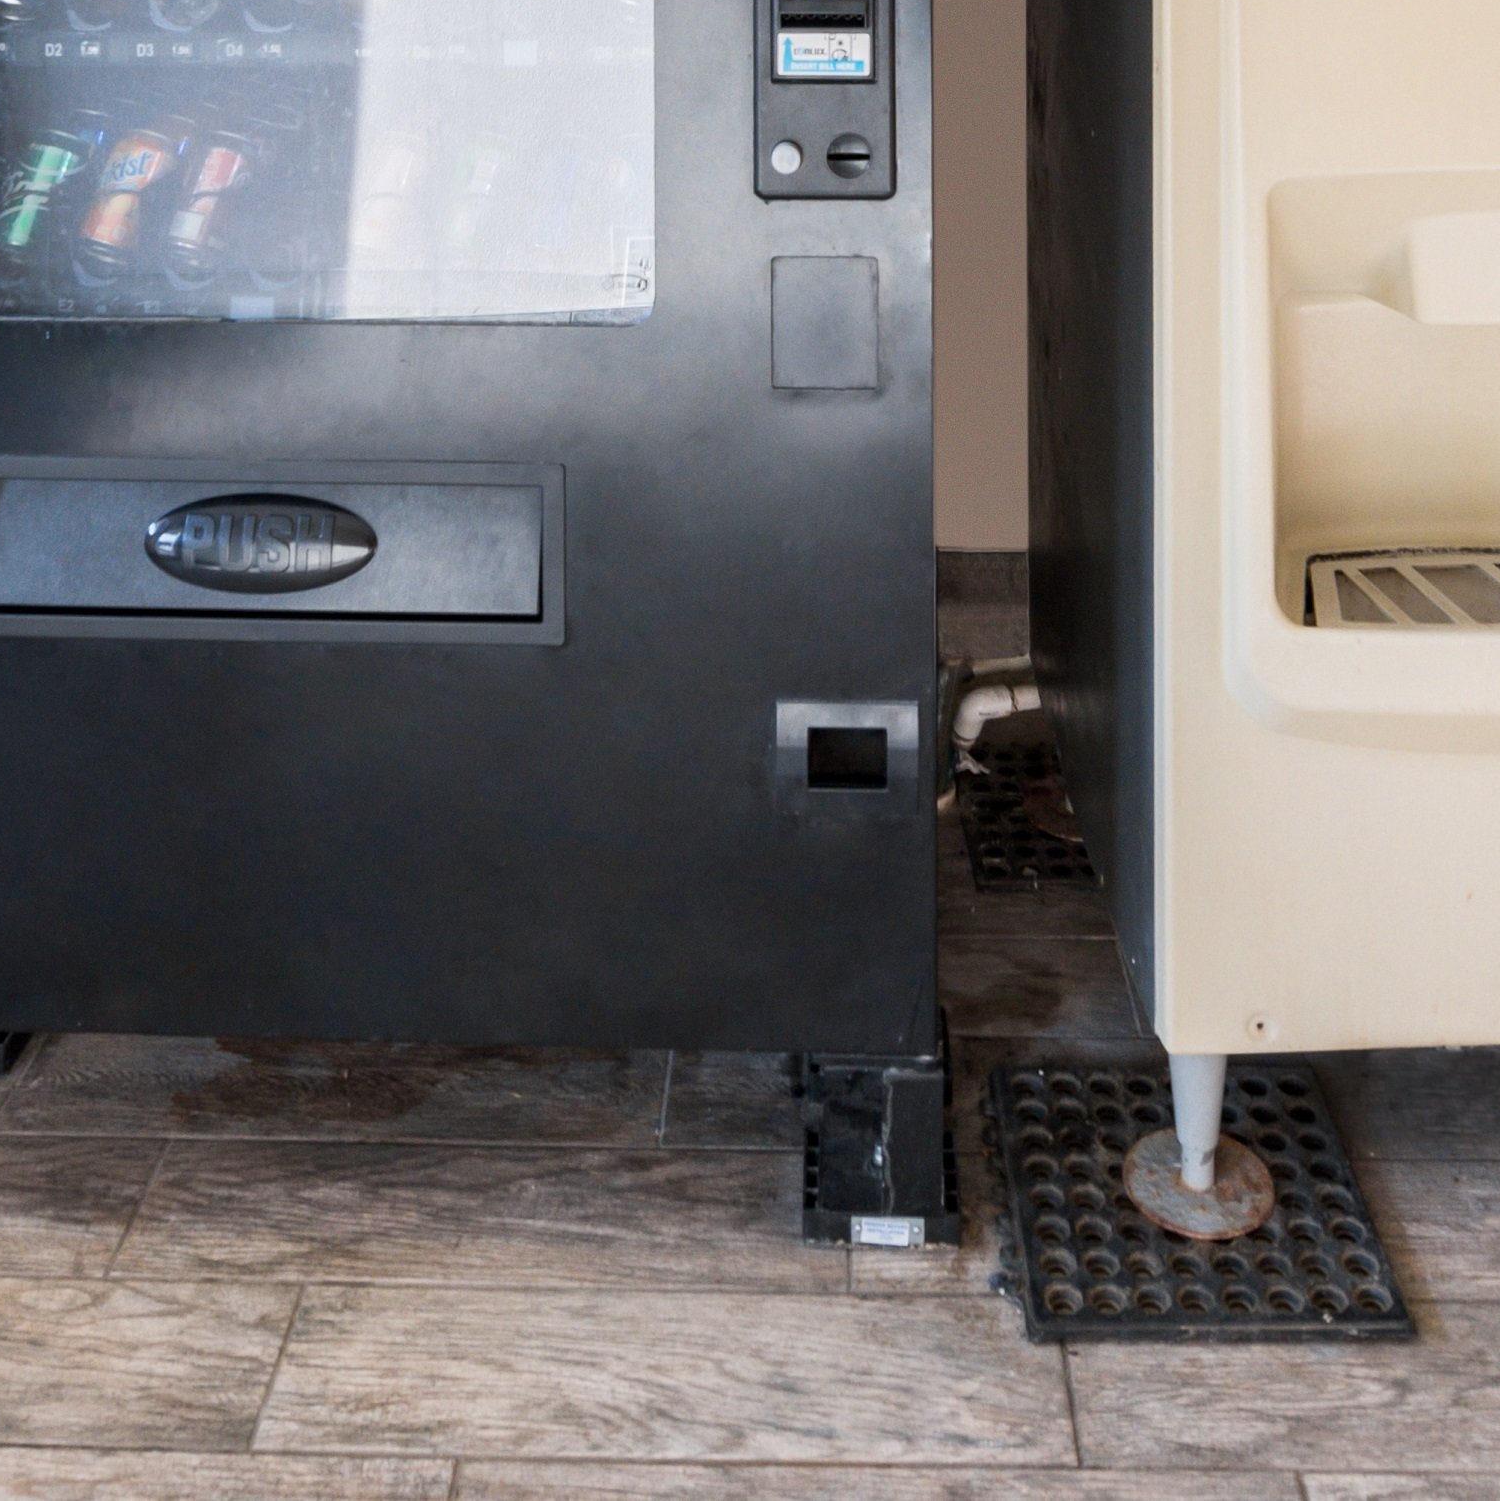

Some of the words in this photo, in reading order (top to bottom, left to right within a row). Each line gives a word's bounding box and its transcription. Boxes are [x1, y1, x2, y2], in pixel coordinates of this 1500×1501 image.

[45, 43, 62, 57] D2
[136, 43, 154, 57] D3
[225, 43, 243, 57] D4
[181, 513, 337, 574] PUSH
